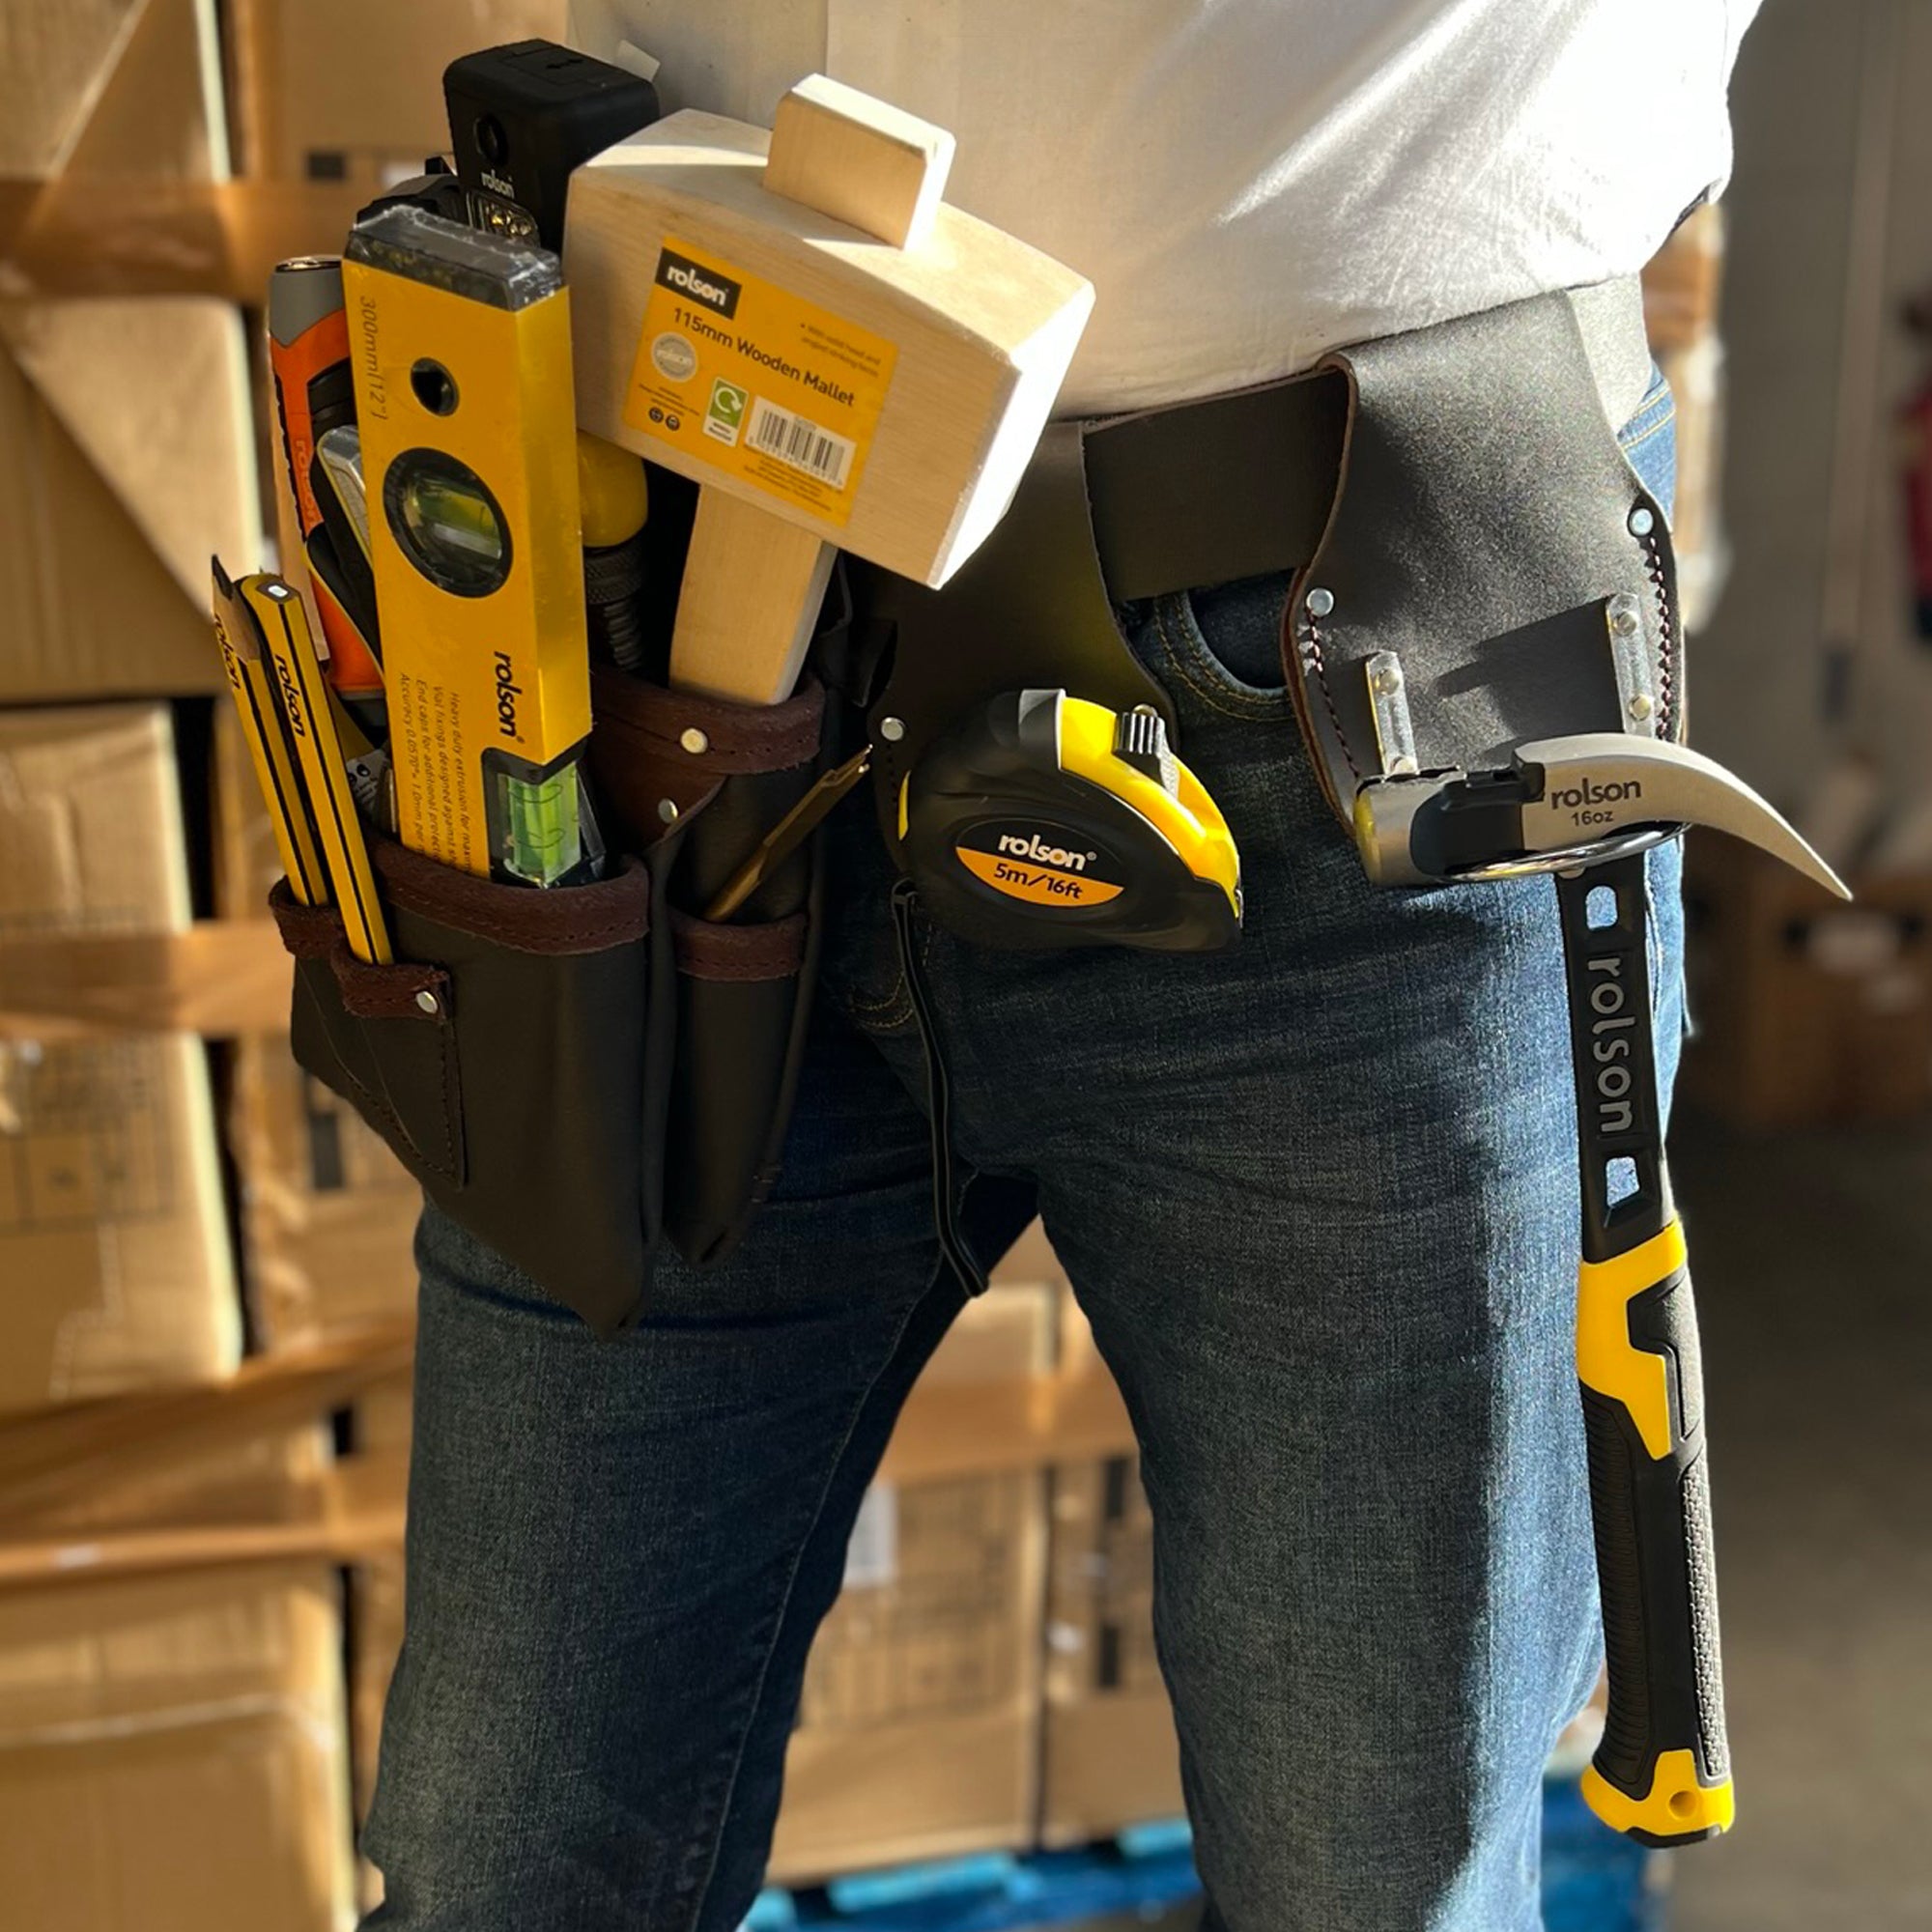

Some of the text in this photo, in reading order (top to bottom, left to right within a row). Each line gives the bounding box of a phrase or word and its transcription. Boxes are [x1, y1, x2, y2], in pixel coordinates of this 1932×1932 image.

[481, 169, 514, 199] rolson
[667, 264, 726, 307] rolson
[674, 307, 734, 349] 115mm
[736, 336, 801, 382] Wooden
[803, 370, 856, 408] Mallet
[214, 612, 241, 690] rolson
[274, 654, 305, 737] rolson
[401, 671, 412, 727] Accuracy
[416, 678, 428, 703] End
[433, 686, 444, 709] Vial
[450, 691, 461, 728] Heavy
[493, 650, 524, 739] rolson
[418, 704, 429, 732] caps
[435, 709, 446, 750] fixings
[422, 734, 432, 753] for
[452, 729, 463, 756] duty
[425, 753, 438, 811] additional
[439, 751, 452, 804] designed
[455, 757, 468, 812] extrusion
[1550, 778, 1642, 811] rolson
[441, 805, 455, 846] against
[461, 812, 470, 831] for
[1570, 810, 1615, 827] 16oz
[998, 834, 1088, 870] rolson
[994, 863, 1083, 900] 5m/16ft
[1587, 955, 1636, 1134] rolson
